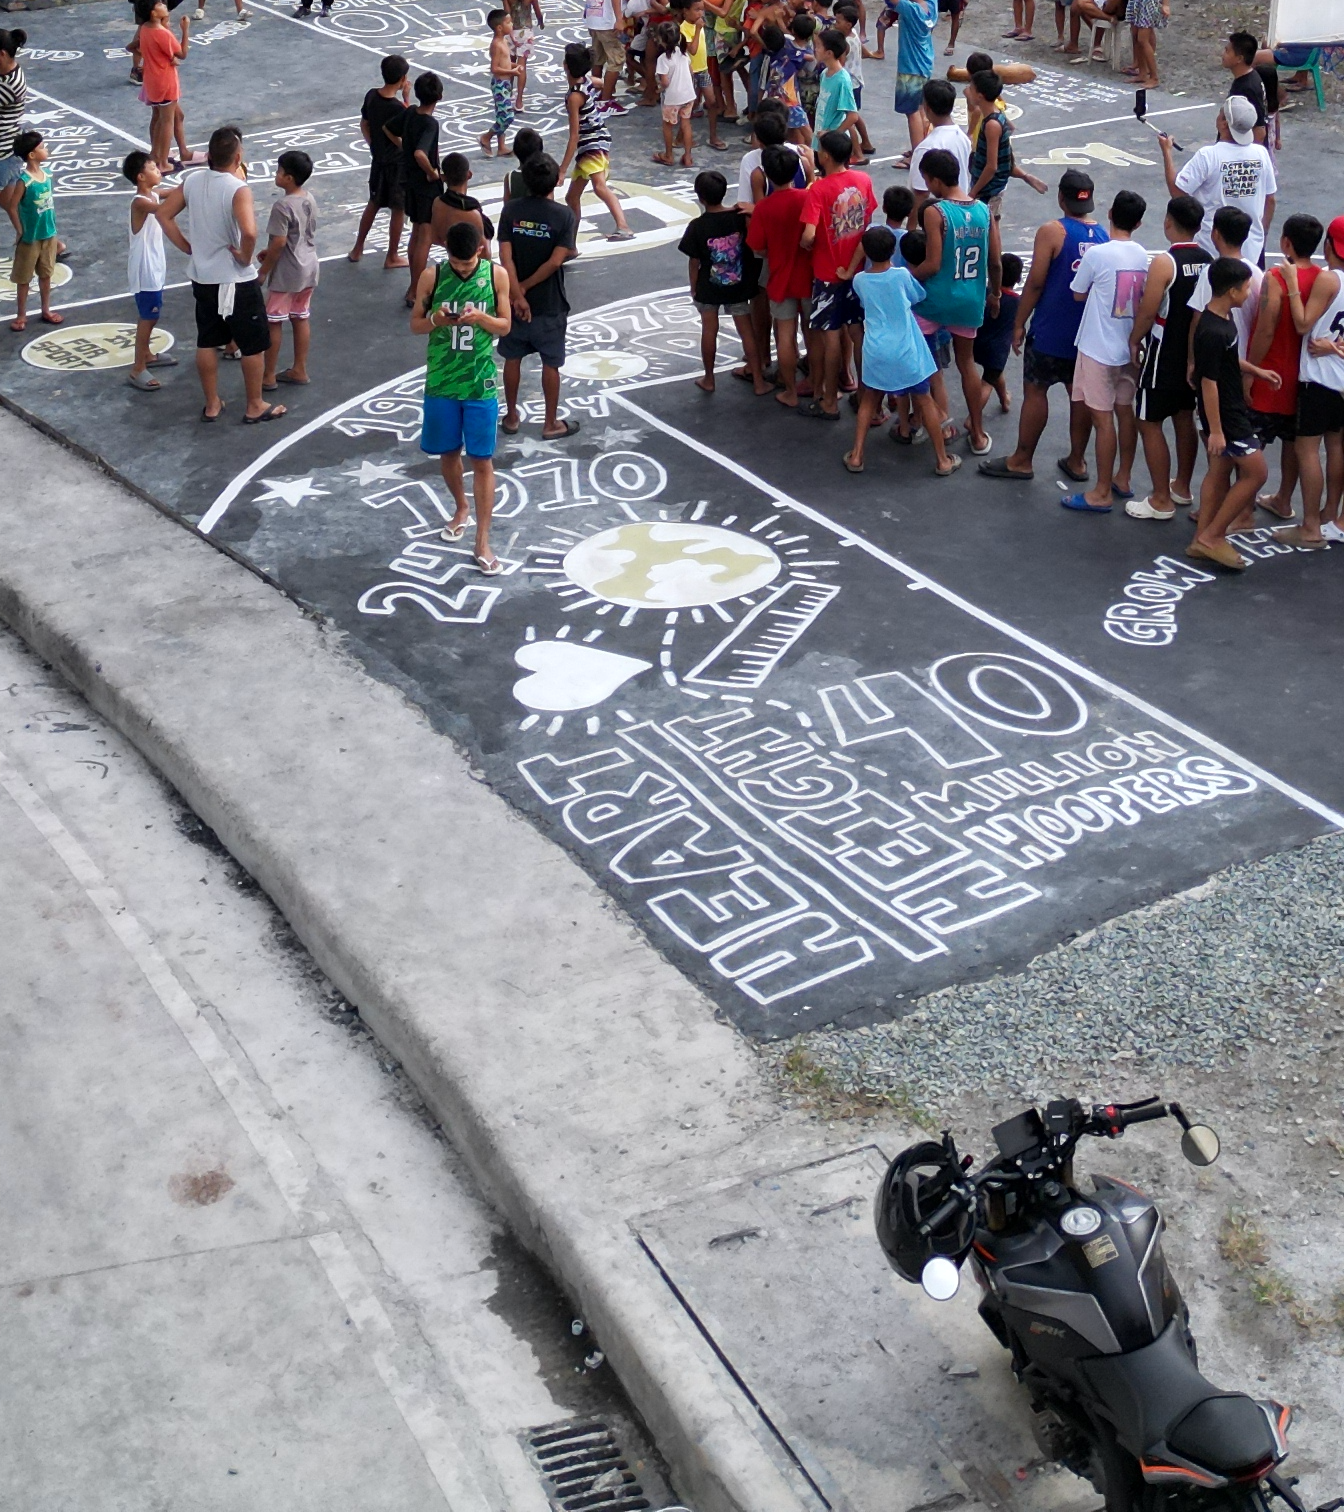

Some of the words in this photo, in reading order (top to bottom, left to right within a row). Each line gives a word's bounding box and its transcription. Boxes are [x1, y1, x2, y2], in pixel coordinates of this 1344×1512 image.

[512, 227, 551, 238] PINEDA
[953, 246, 981, 280] 12
[30, 340, 95, 369] SPORT
[62, 337, 110, 359] FOR
[450, 325, 474, 351] 12
[1102, 555, 1216, 646] GROW
[818, 652, 1088, 770] 40
[663, 707, 1042, 935] HEIGHT
[911, 731, 1187, 823] MILLION
[963, 756, 1258, 869] HOOPERS
[518, 748, 875, 1005] HEART
